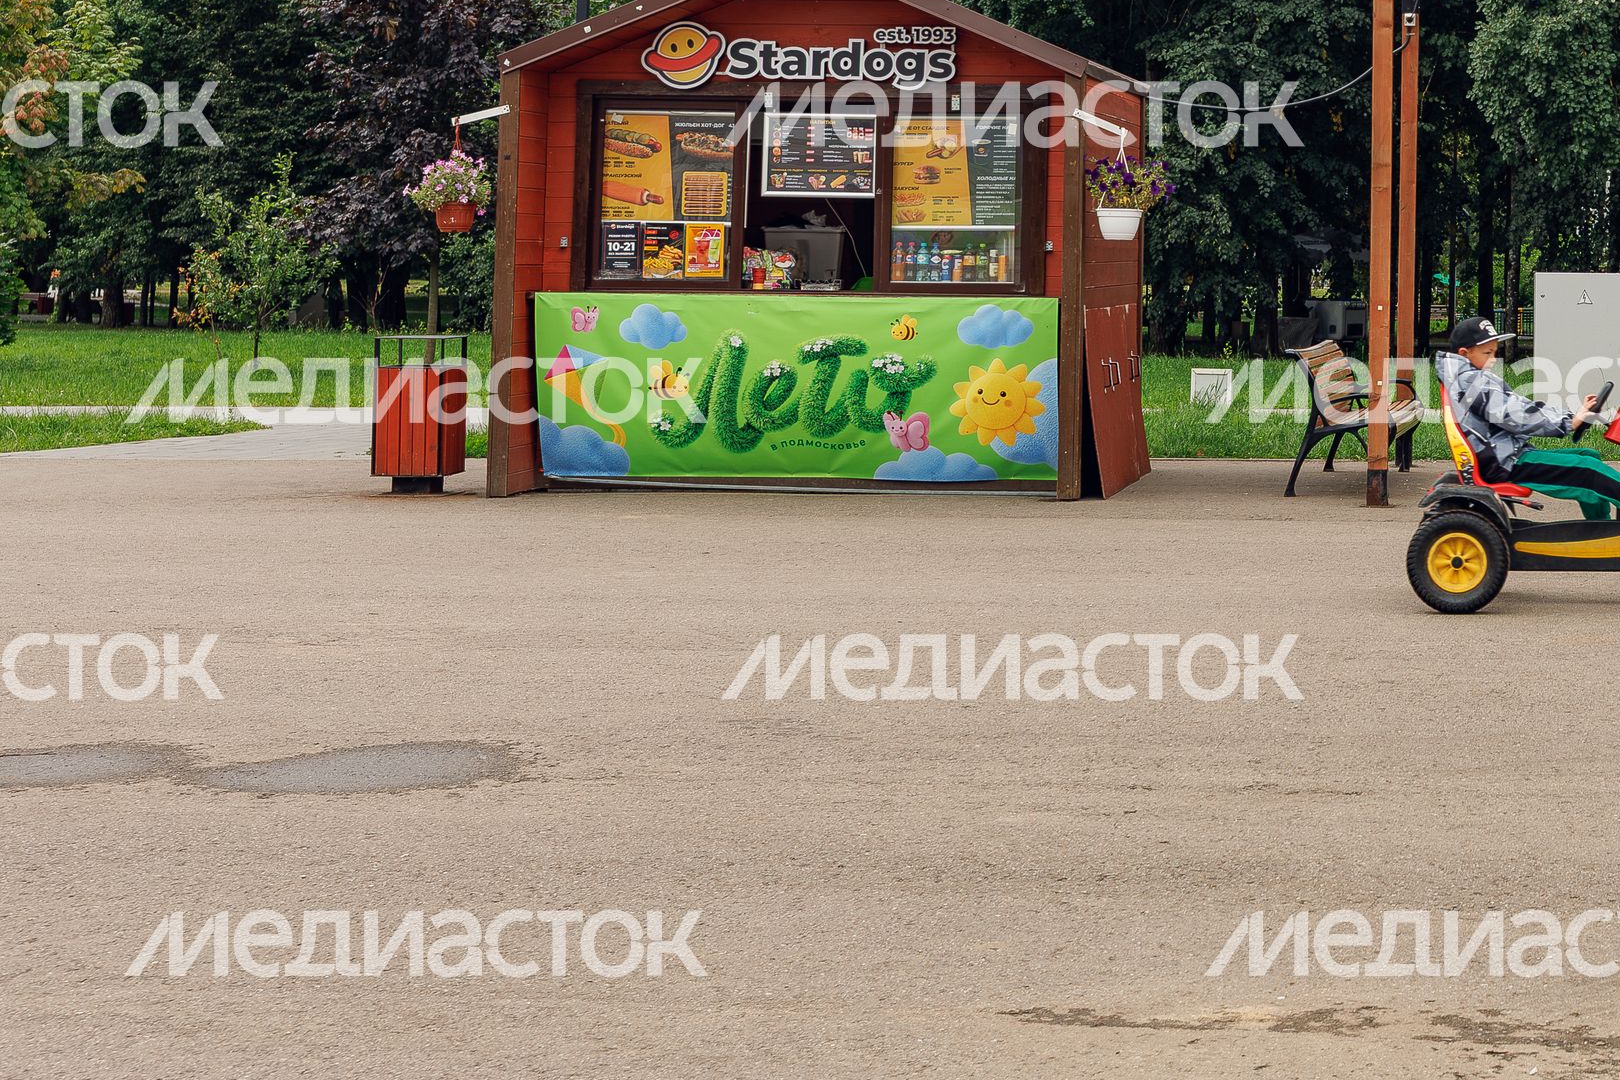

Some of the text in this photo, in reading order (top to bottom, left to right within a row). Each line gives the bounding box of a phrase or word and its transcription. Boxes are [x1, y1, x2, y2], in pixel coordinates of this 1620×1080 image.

[874, 27, 956, 44] est. 1993
[726, 39, 955, 89] Stardogs
[607, 242, 636, 251] 10-21
[650, 329, 940, 454] Лето
